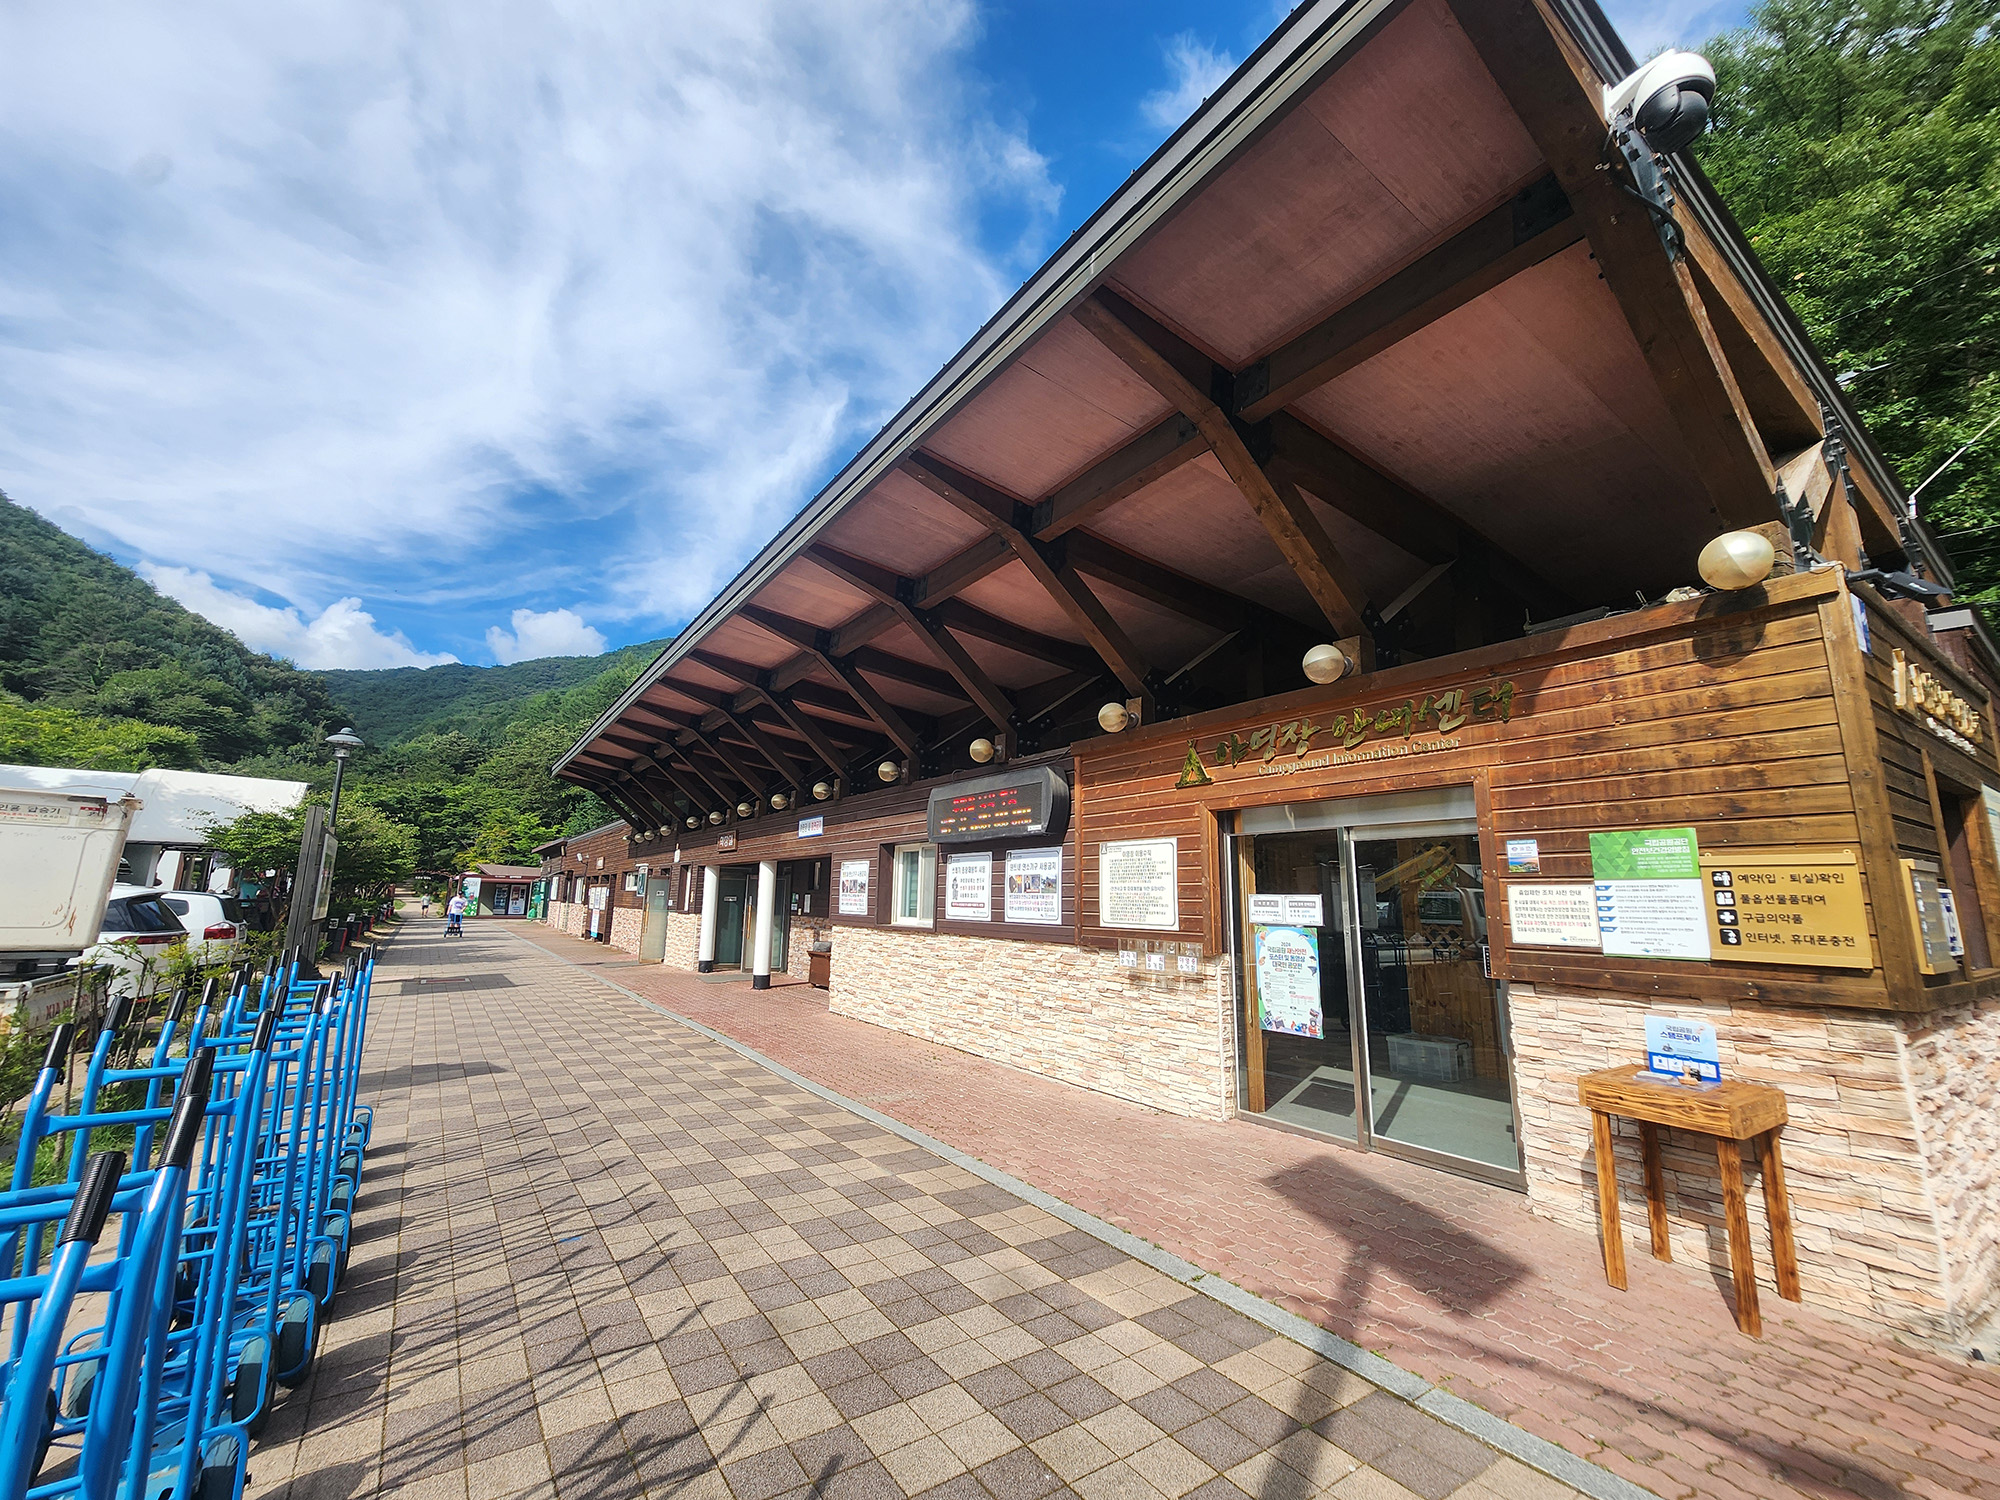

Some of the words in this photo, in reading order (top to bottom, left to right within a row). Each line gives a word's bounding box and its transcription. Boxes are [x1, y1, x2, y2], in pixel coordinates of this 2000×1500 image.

[1215, 717, 1322, 768] 야영장
[1332, 680, 1515, 749] 안내센터
[1257, 754, 1330, 776] Campground
[1332, 744, 1408, 766] Information
[1411, 736, 1462, 755] Center
[1737, 873, 1776, 884] 예약(입
[1790, 873, 1845, 884] 퇴실)확인
[1740, 894, 1826, 905] 풀옵션물품대여
[1743, 913, 1803, 924] 구급의약품
[1790, 934, 1856, 947] 휴대폰충전
[1269, 953, 1284, 961] 포스터
[1666, 1025, 1692, 1033] 국립공원
[1660, 1031, 1701, 1042] 스탬프투어
